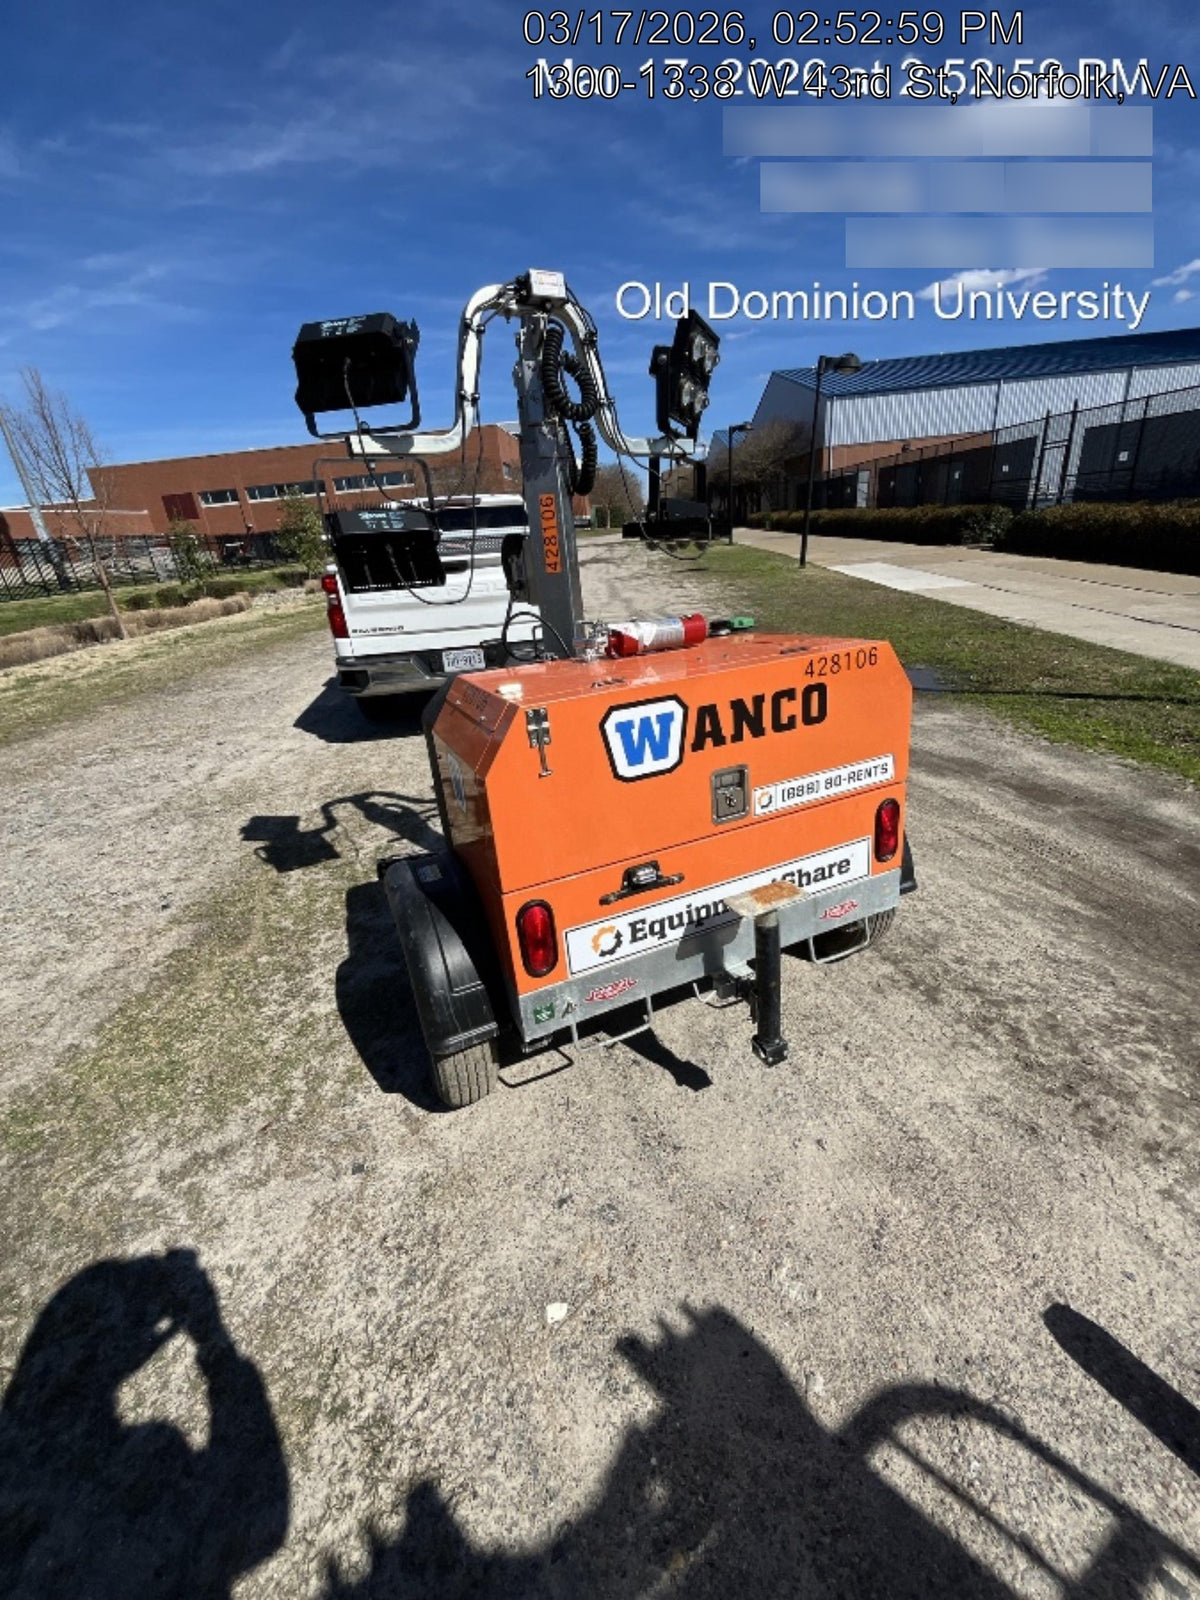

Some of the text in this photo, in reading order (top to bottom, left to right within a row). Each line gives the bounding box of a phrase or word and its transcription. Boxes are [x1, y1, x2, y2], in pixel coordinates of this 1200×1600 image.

[539, 496, 560, 572] 428106
[804, 646, 879, 678] 428106
[608, 681, 828, 772] WANCO
[824, 762, 889, 790] 80-RENTS
